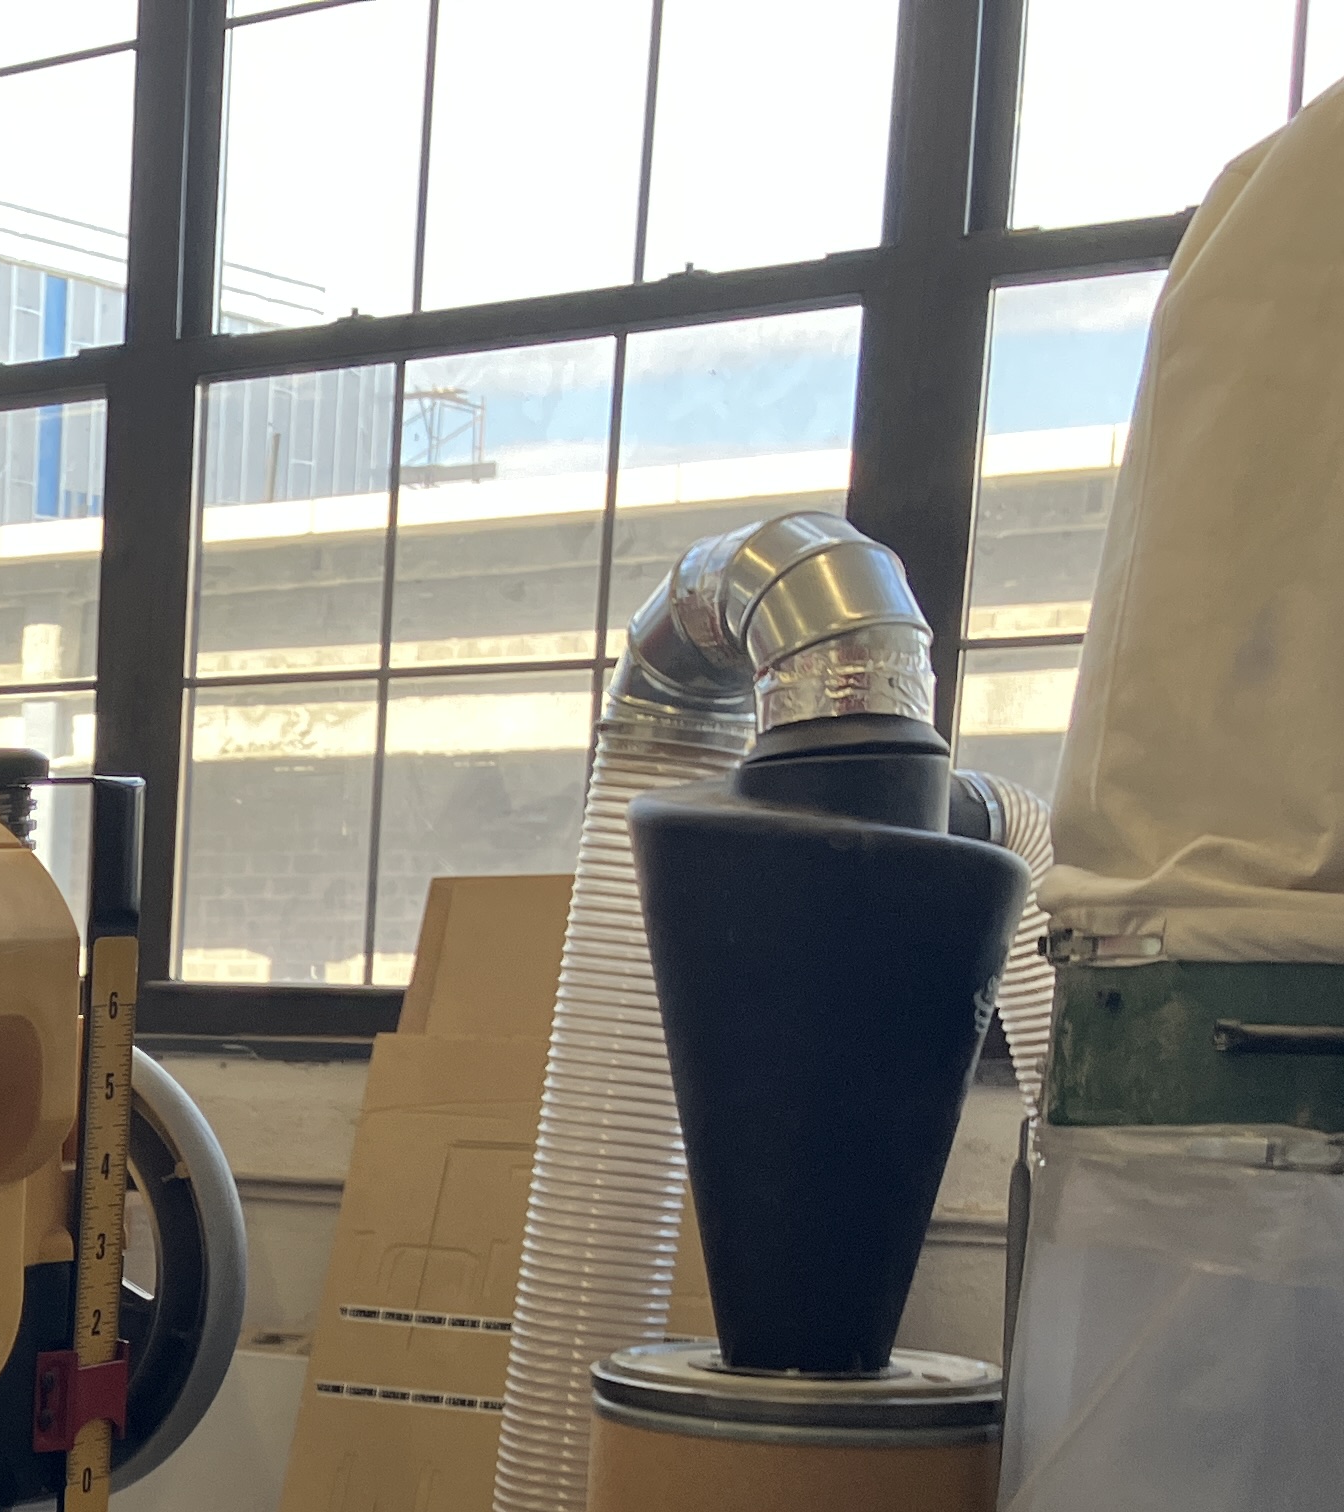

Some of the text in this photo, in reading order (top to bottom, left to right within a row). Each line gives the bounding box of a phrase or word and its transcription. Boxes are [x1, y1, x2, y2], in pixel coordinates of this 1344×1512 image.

[109, 992, 118, 1019] 6
[105, 1073, 115, 1100] 5
[100, 1153, 110, 1180] 4
[96, 1233, 106, 1260] 3
[91, 1309, 101, 1336] 2
[82, 1467, 92, 1493] 0
